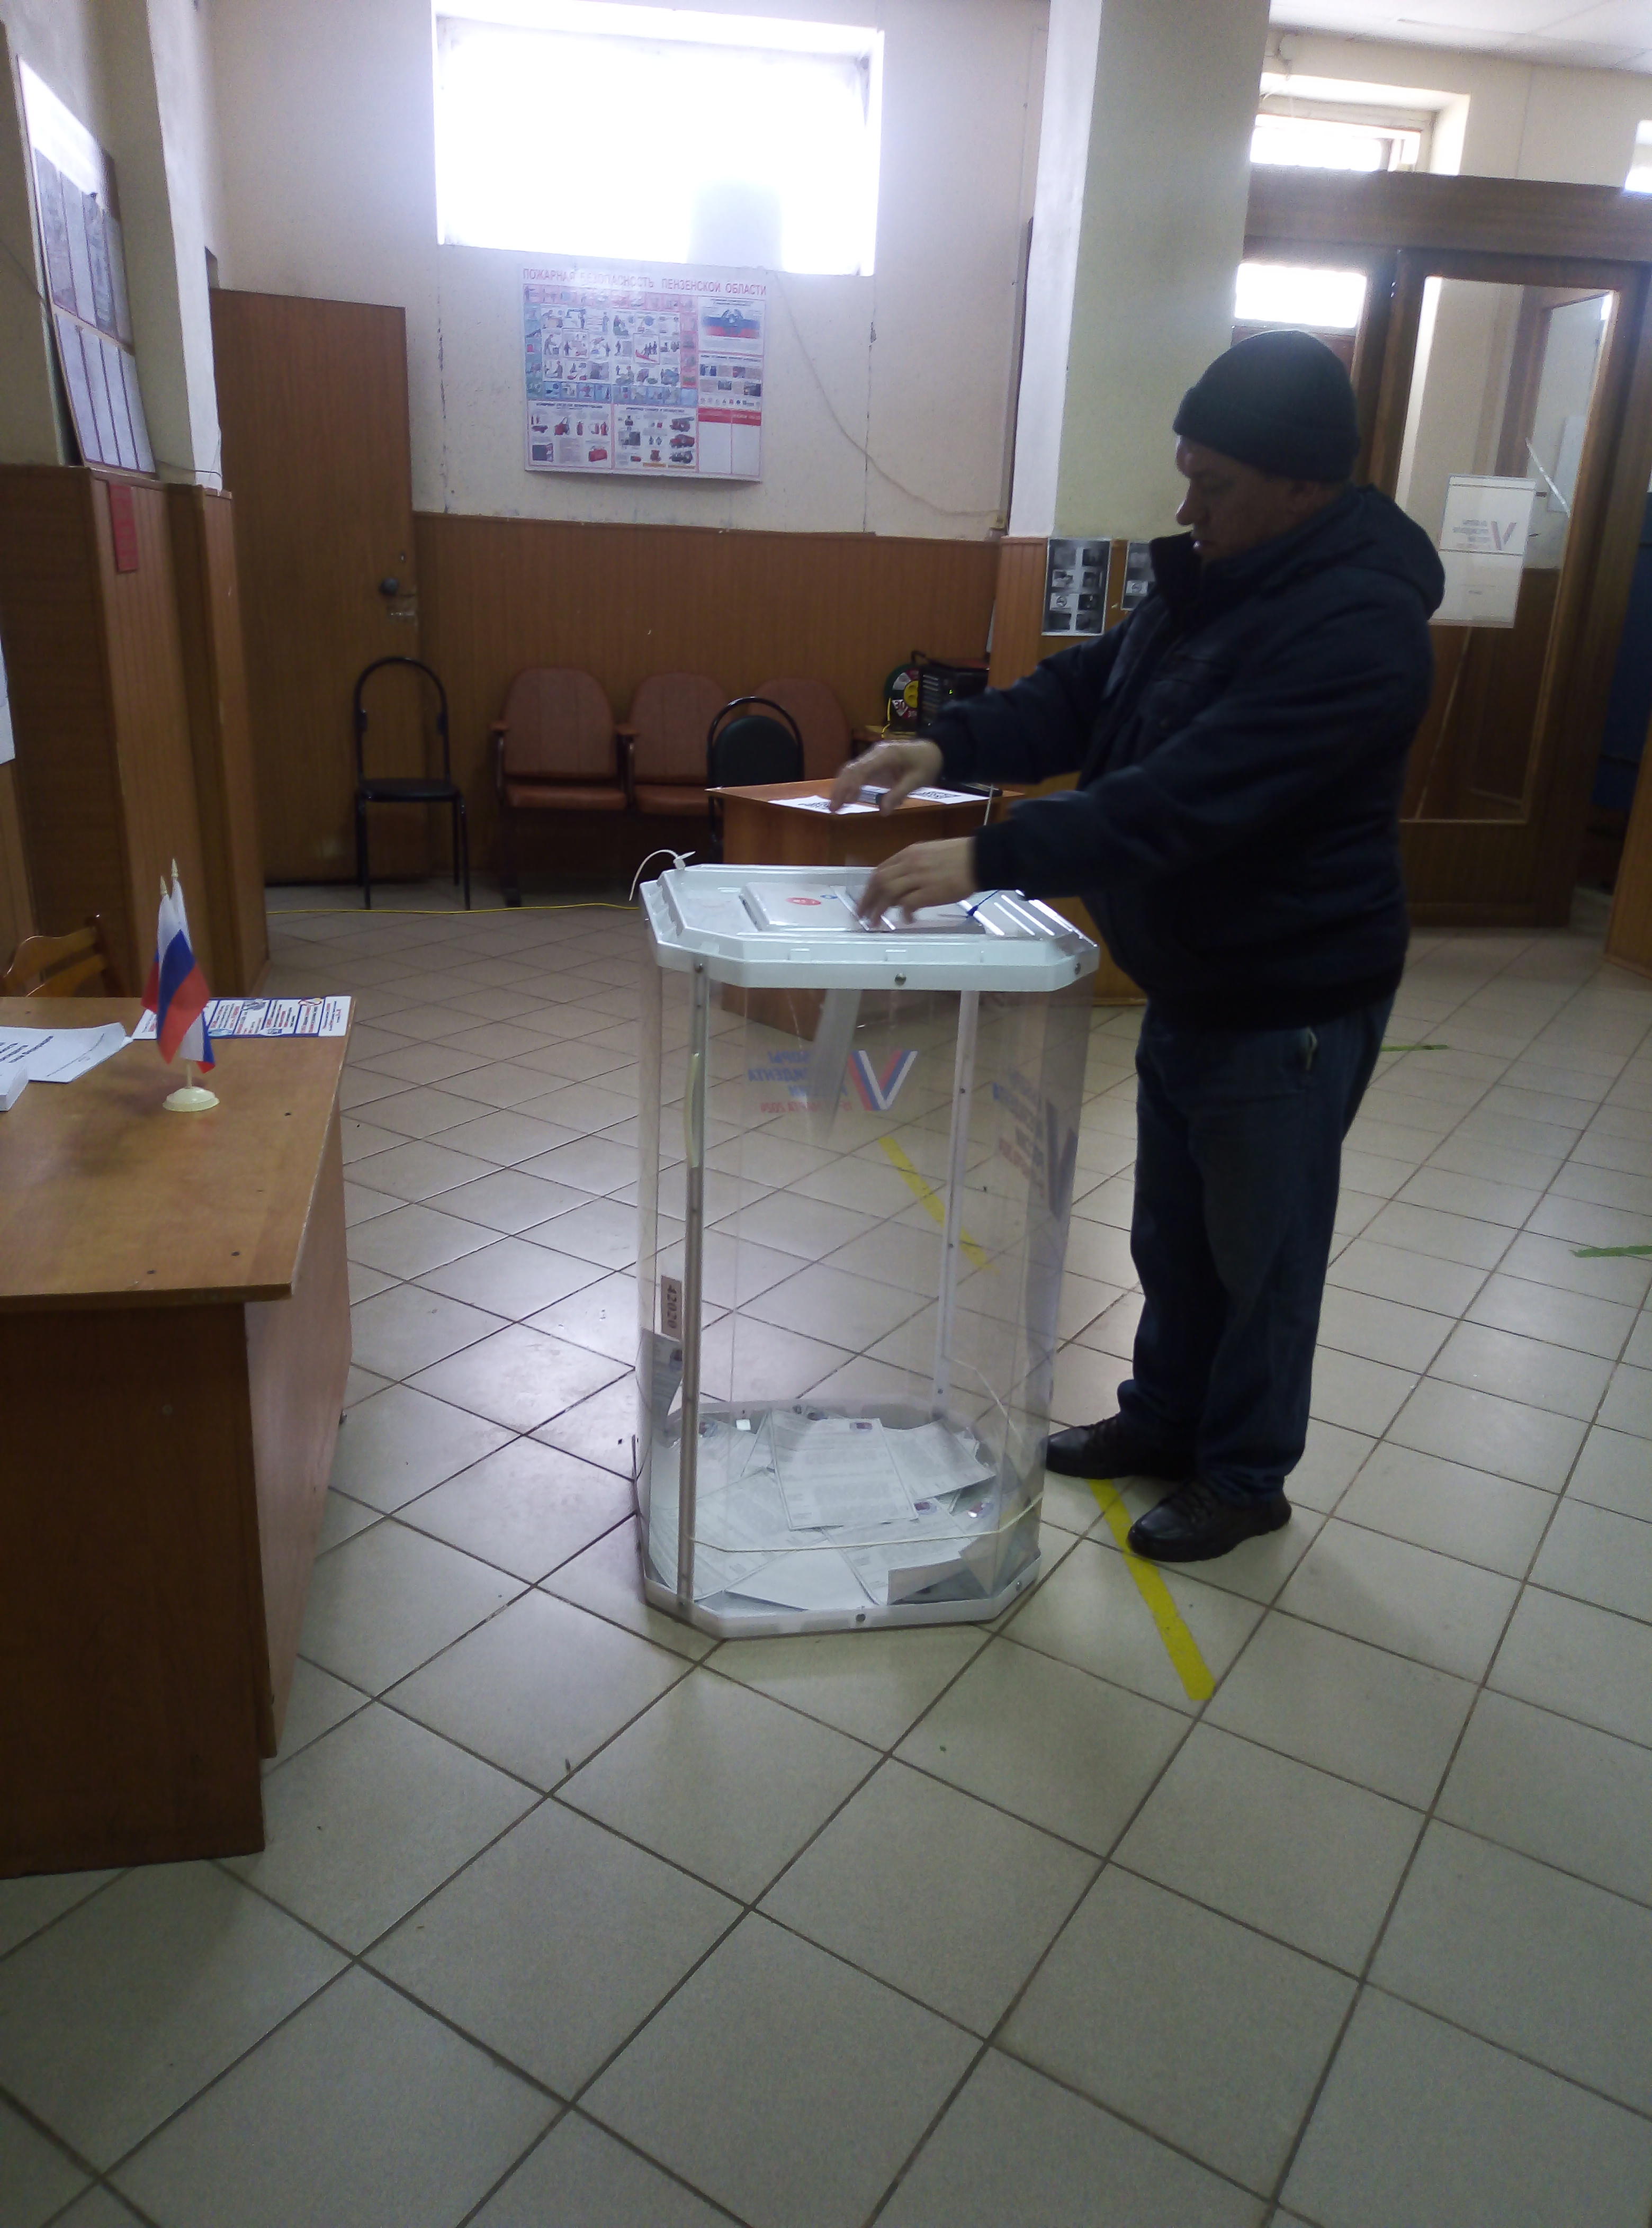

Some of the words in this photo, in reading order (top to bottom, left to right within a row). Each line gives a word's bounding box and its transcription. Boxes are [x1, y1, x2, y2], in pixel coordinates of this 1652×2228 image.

[523, 268, 575, 281] ПОЖАРНАЯ
[580, 272, 654, 288] БЕЗОПАСНОСТЬ
[662, 278, 721, 292] ПЕНЗЕНСКОЙ
[725, 283, 766, 296] ОБЛАСТИ
